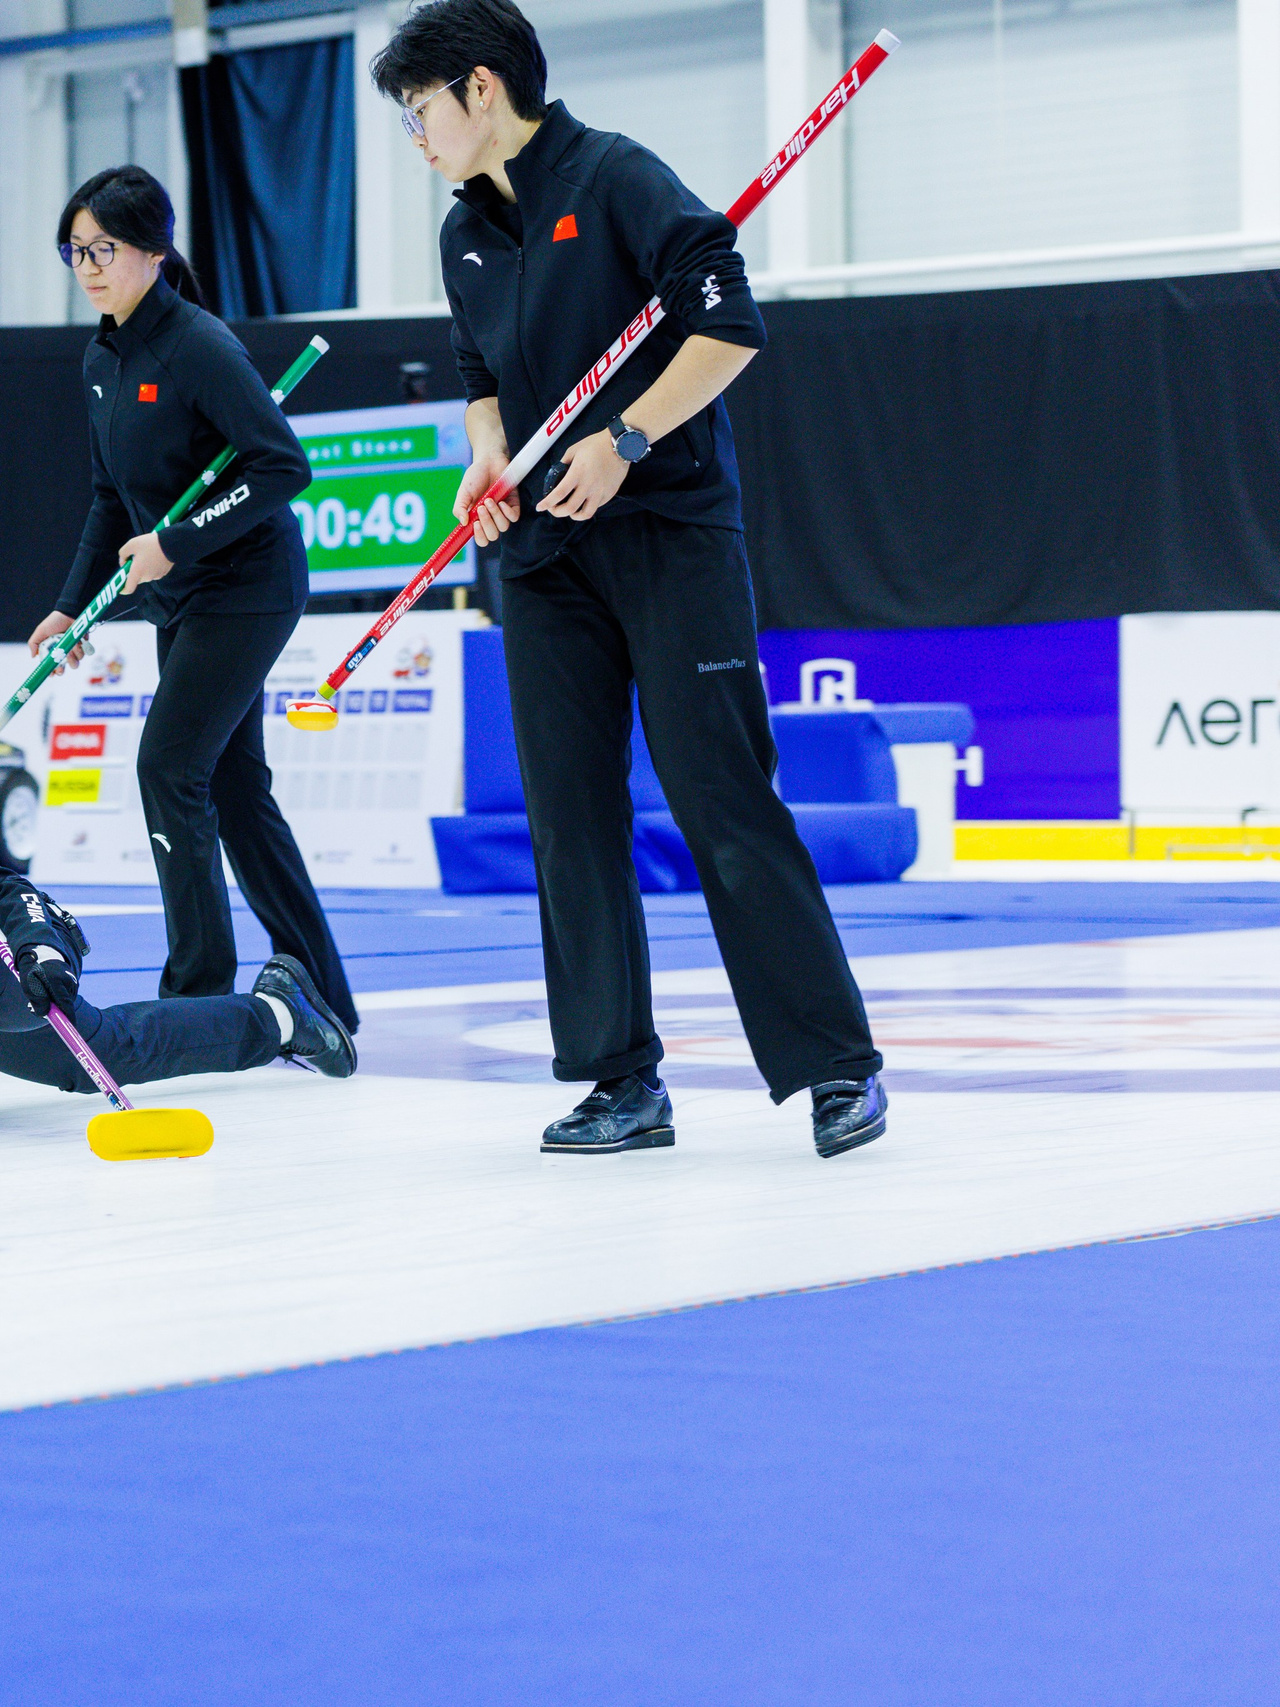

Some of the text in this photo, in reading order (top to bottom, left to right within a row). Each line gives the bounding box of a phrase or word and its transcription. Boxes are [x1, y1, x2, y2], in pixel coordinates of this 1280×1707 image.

[760, 67, 861, 189] Hardline
[545, 302, 661, 438] Hardline
[308, 443, 342, 461] ast
[191, 483, 251, 528] CHINA
[288, 490, 427, 550] 00:49
[70, 568, 128, 640] dline
[379, 568, 436, 636] Hardline
[696, 658, 747, 673] BalancePlus
[1155, 698, 1280, 747] лег
[20, 893, 46, 923] CHINA
[75, 1051, 108, 1093] Hardline
